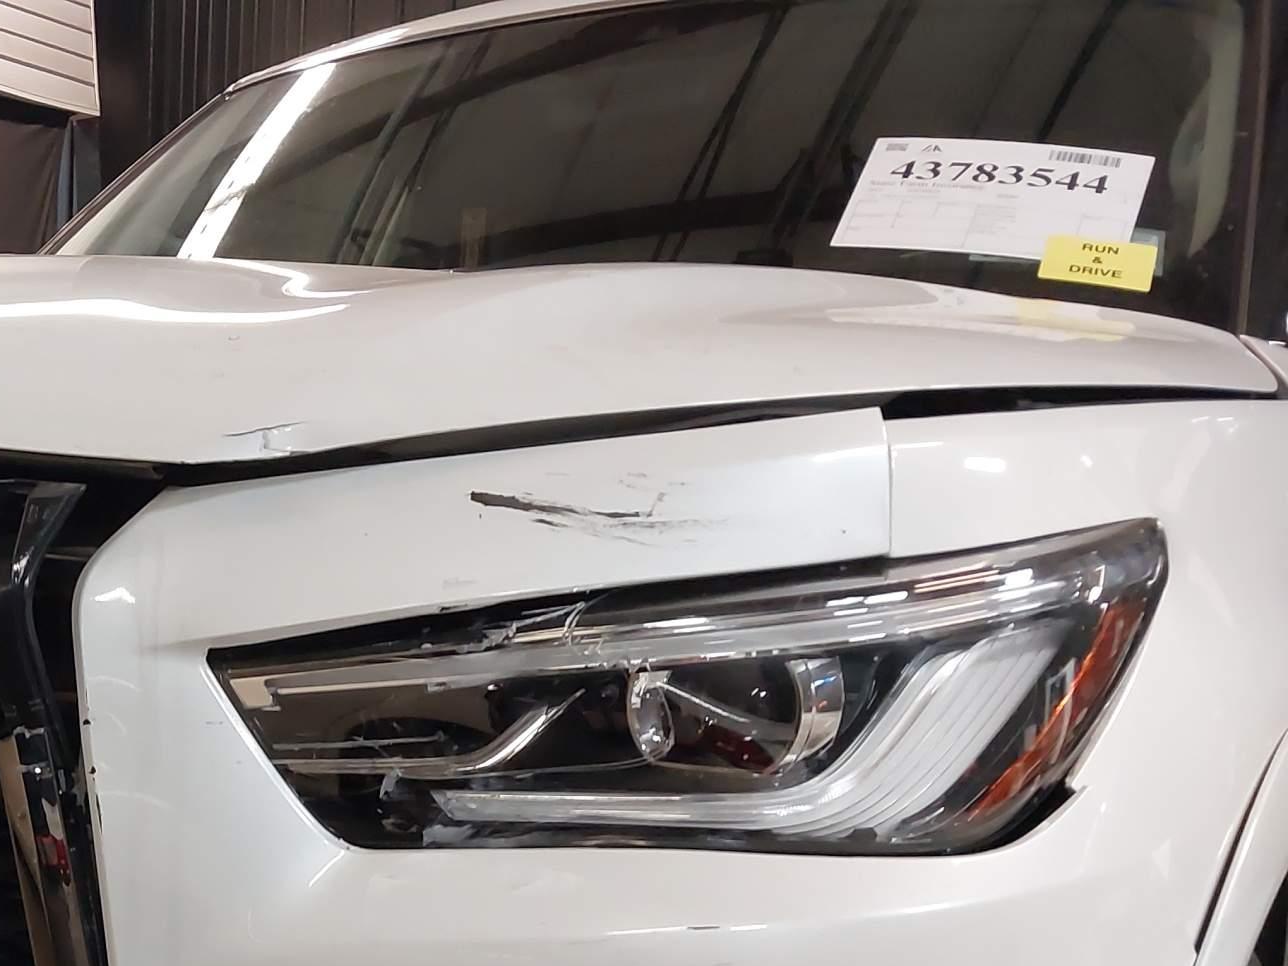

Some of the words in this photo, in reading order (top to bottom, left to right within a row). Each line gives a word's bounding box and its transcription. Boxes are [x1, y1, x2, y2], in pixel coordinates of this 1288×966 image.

[890, 160, 1108, 194] 43783544
[1081, 242, 1120, 255] RUN
[1092, 256, 1103, 264] &
[1068, 264, 1124, 279] DRIVE
